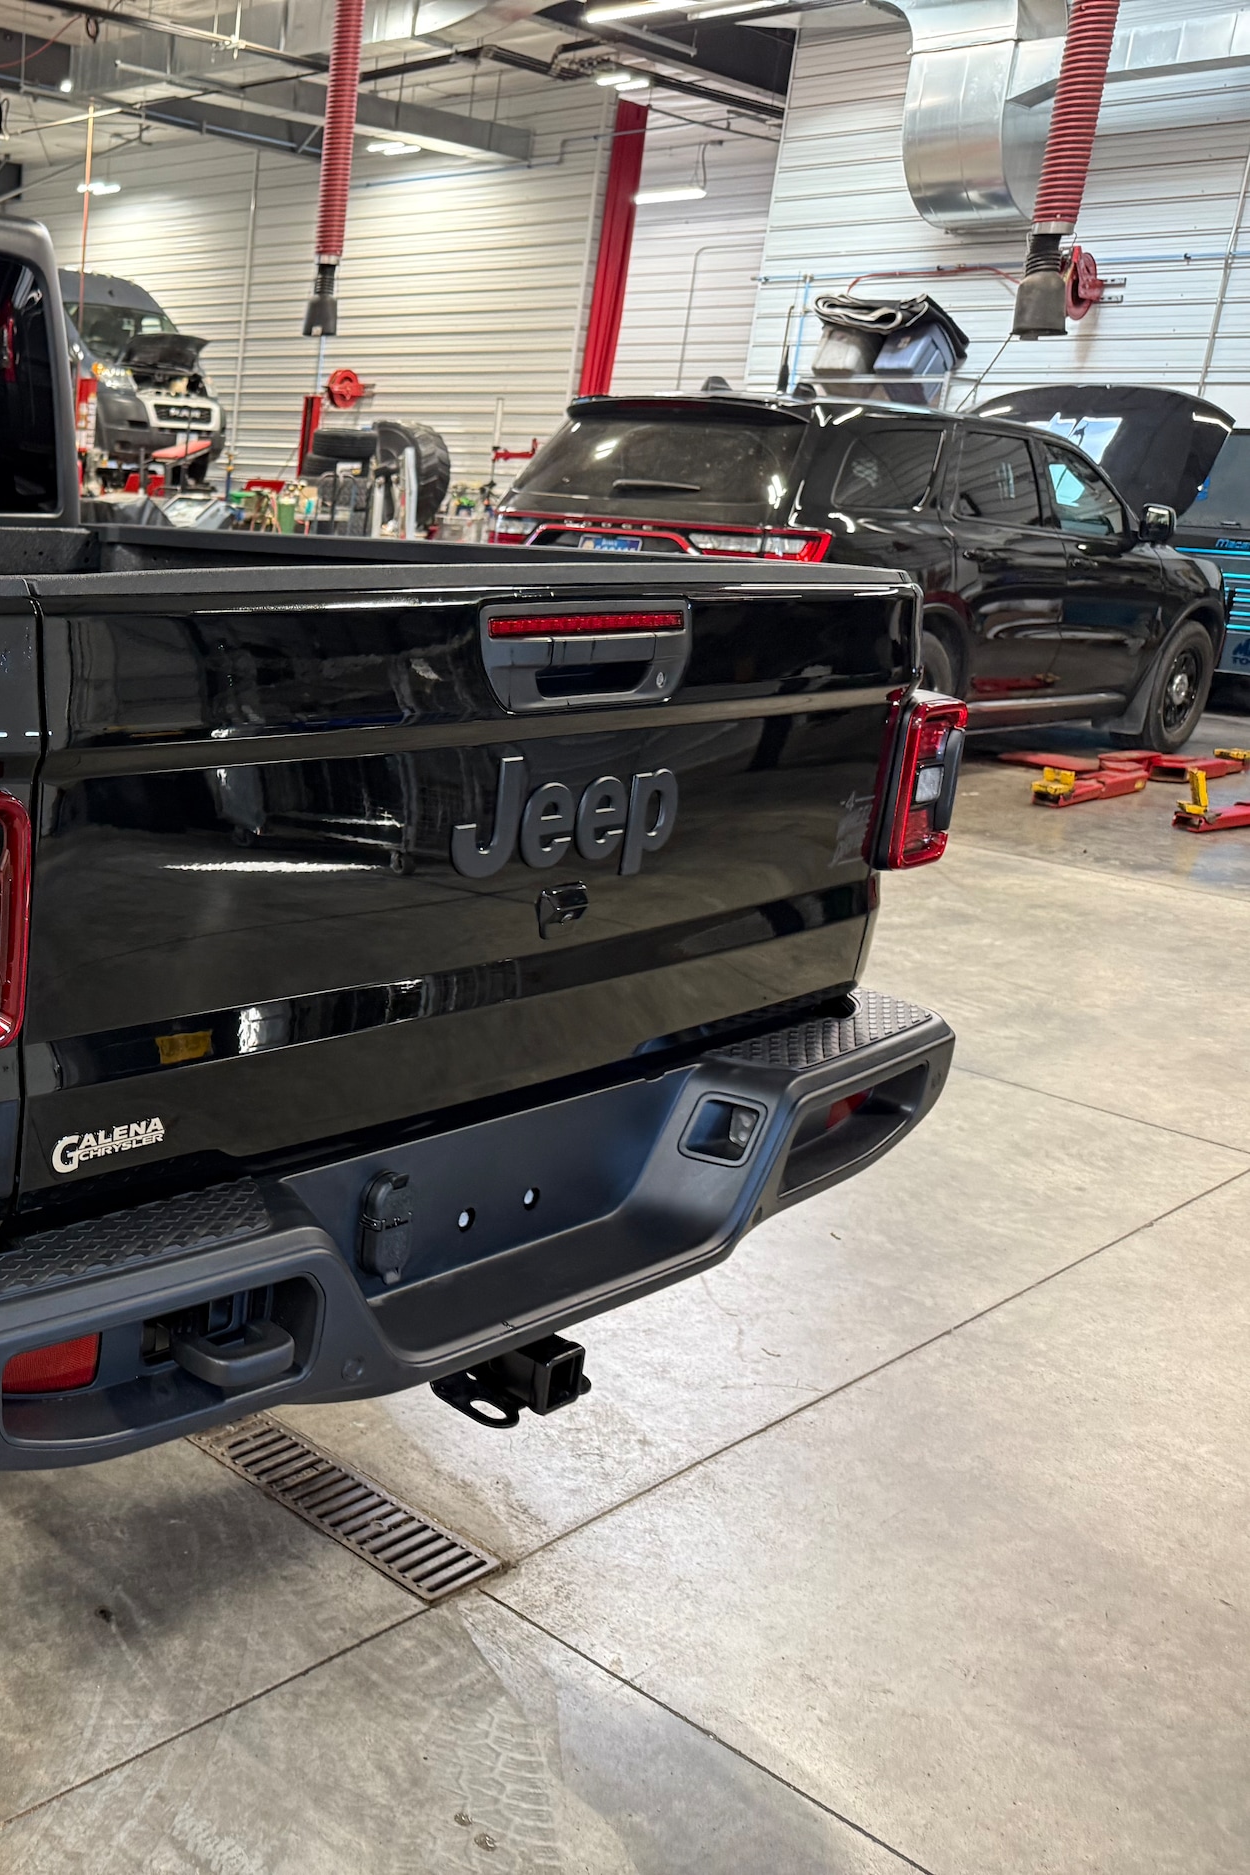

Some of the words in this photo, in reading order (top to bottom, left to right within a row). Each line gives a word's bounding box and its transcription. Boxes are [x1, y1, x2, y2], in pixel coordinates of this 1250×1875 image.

[451, 757, 678, 878] Jeep
[52, 1117, 164, 1173] GALENA
[78, 1133, 164, 1161] CHRYSLER
